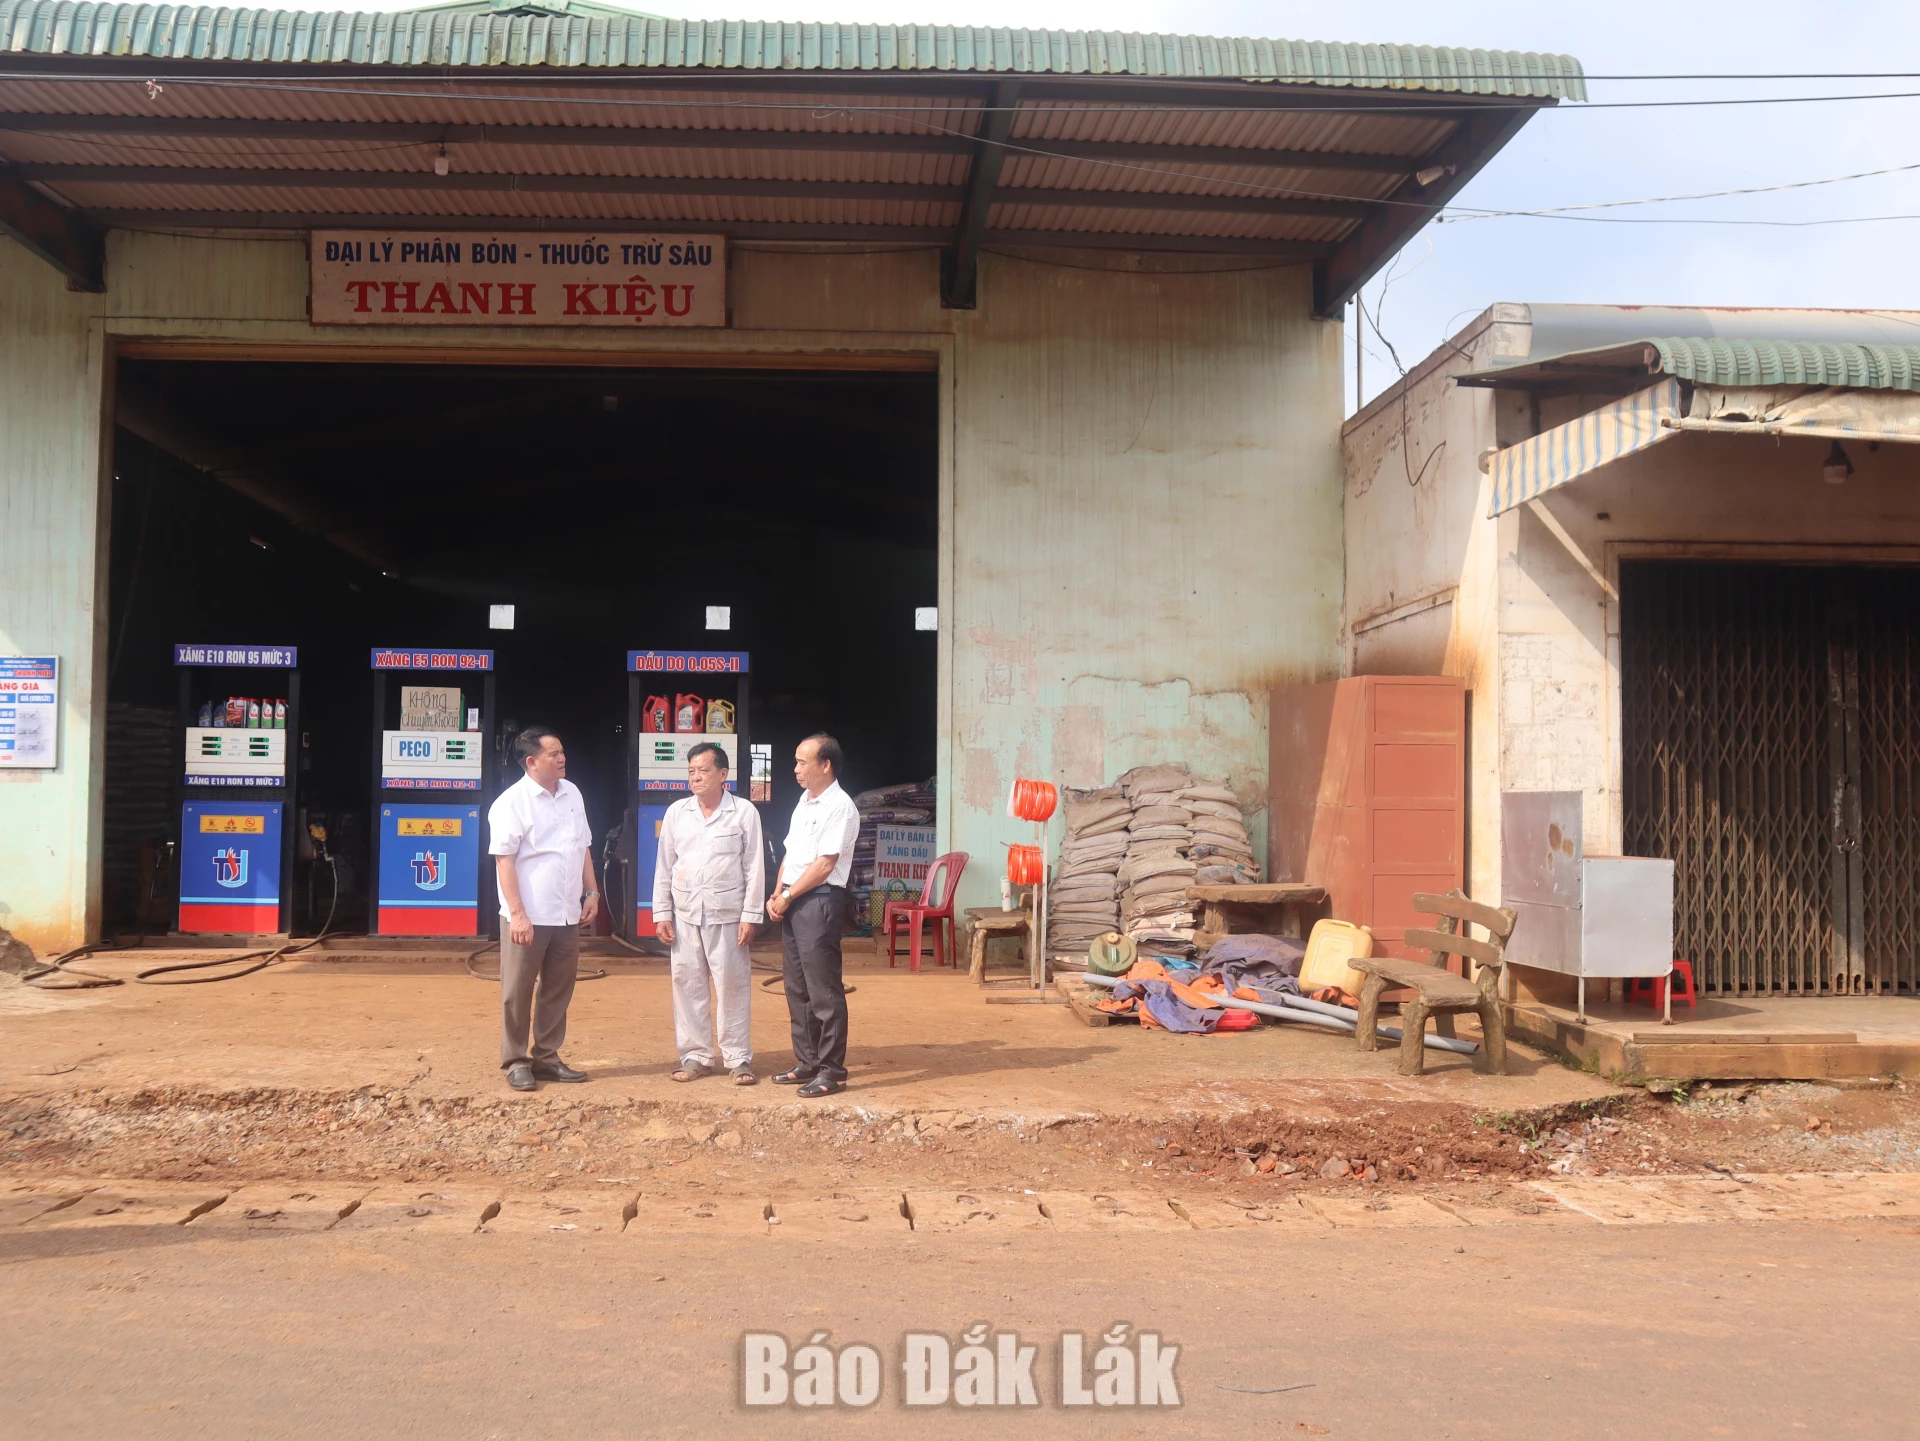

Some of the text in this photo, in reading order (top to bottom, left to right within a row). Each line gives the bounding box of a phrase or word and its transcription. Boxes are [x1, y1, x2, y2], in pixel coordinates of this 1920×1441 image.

[325, 241, 362, 268] ĐẠI
[369, 237, 395, 264] LÝ
[401, 237, 461, 264] PHÂN
[539, 236, 610, 265] THUỐC
[620, 237, 664, 265] TRỪ
[668, 240, 712, 266] SÂU
[345, 274, 695, 323] THANH KIỆU
[179, 646, 291, 665] XĂNG E10 RON 95 MỨC 3
[376, 651, 489, 668] XĂNG E5 RON 92-II
[636, 651, 740, 672] DẦU DO 0.05S-II
[398, 740, 431, 758] PECO
[188, 775, 280, 786] XĂNG E10 RON 95 MỨC 3
[386, 778, 414, 787] XĂNG
[430, 780, 451, 788] RON
[670, 782, 685, 790] DO
[880, 830, 894, 842] ĐẠI
[896, 829, 906, 841] LÝ
[877, 861, 911, 879] THANH
